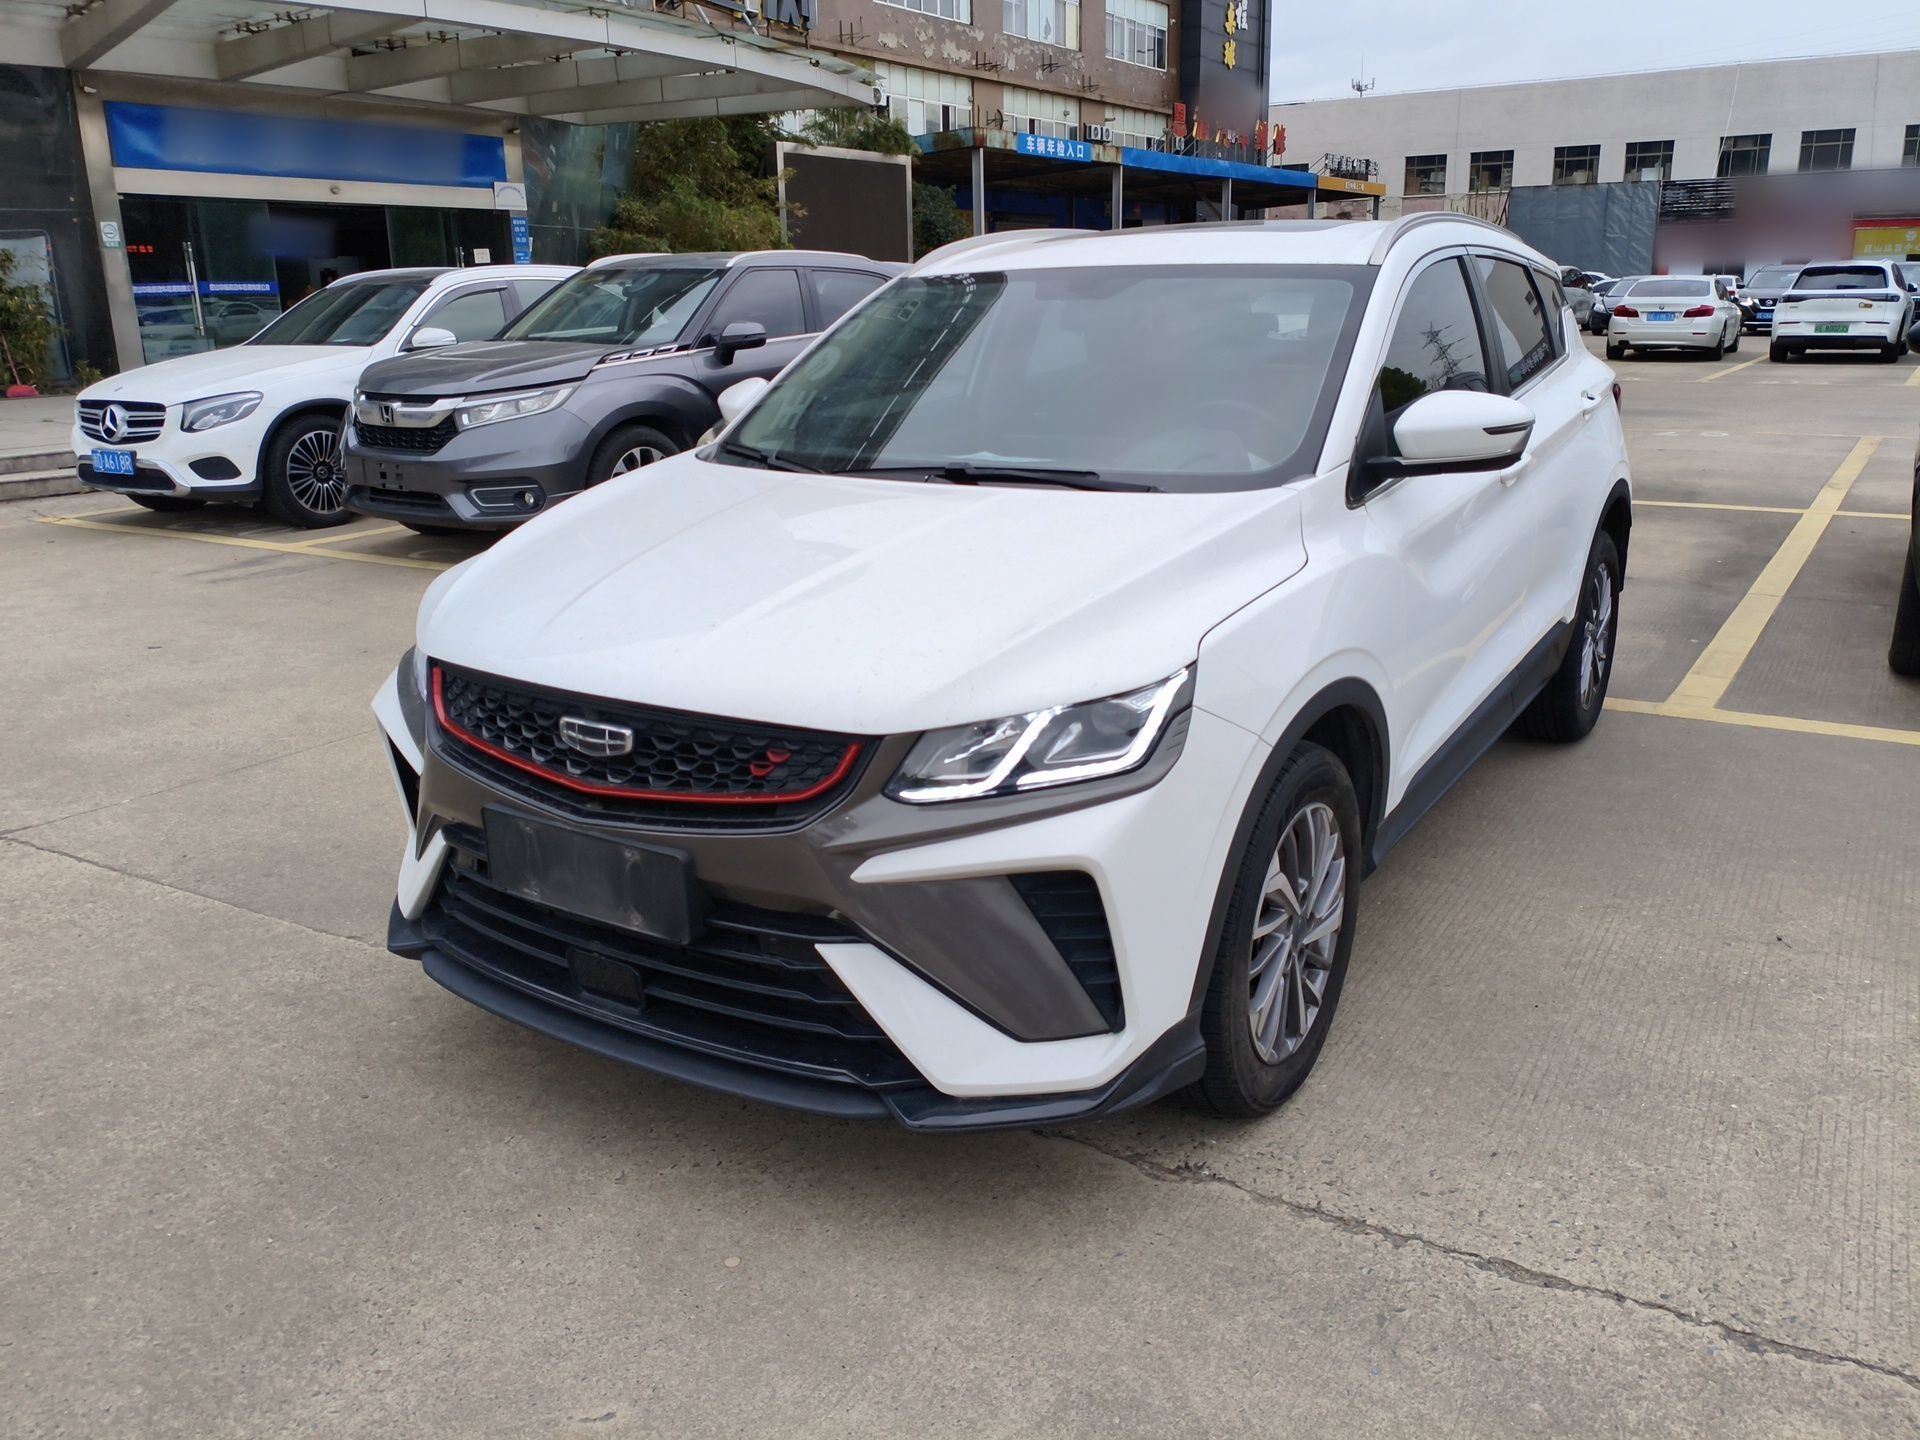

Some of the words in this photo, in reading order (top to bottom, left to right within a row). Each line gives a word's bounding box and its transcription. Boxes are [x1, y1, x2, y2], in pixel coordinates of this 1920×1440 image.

[1026, 135, 1084, 158] 车辆年检入口
